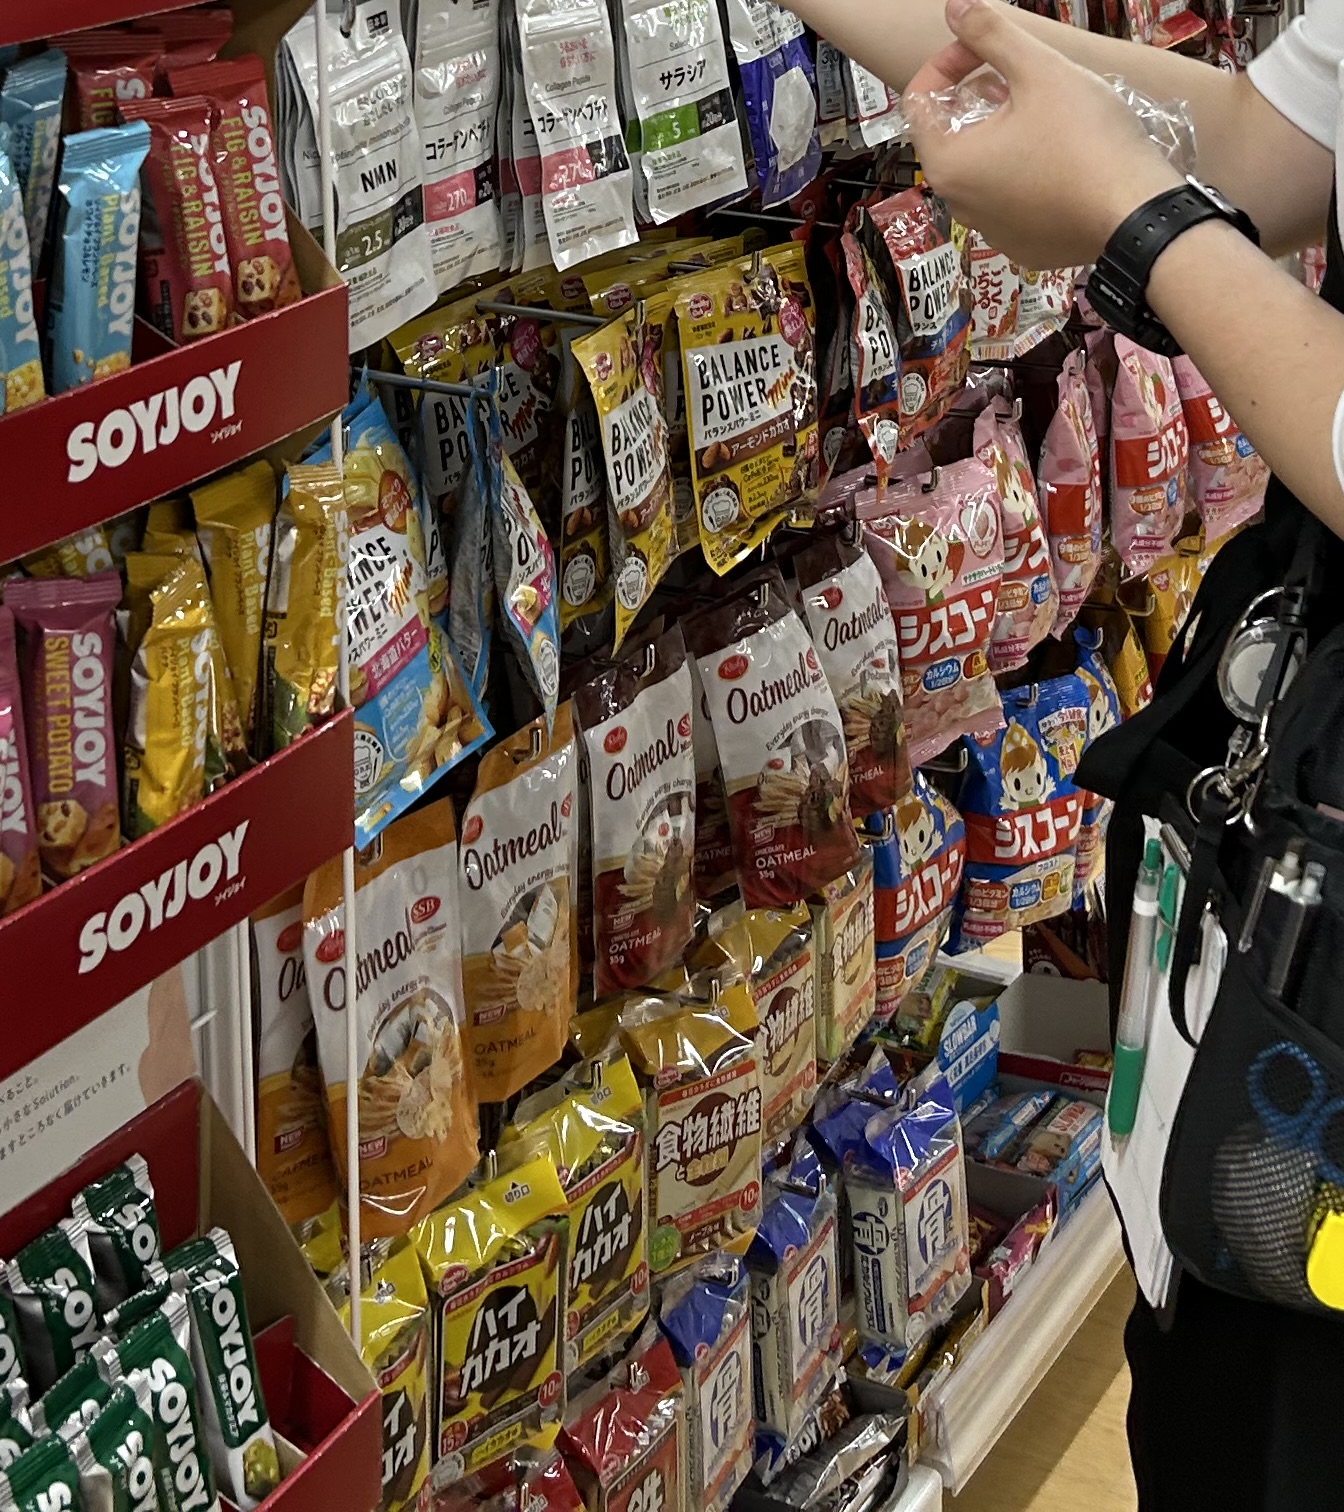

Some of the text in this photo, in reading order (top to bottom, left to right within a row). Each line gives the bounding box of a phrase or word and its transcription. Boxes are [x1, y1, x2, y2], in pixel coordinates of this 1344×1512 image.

[659, 58, 707, 90] サラシア
[181, 184, 198, 198] &
[220, 115, 266, 248] FIG & RAISIN
[241, 105, 290, 244] SOYJOY
[360, 158, 398, 193] NMN
[190, 134, 232, 277] SOYJOY
[110, 189, 141, 336] SOYJOY
[182, 201, 217, 279] RAISIN
[361, 229, 383, 257] 2.5
[908, 249, 956, 293] BALANCE
[698, 343, 781, 390] BALANCE
[66, 359, 244, 484] SOYJOY
[701, 376, 767, 426] POWER
[210, 419, 244, 445] ソイジョイ
[731, 417, 790, 457] アーモンドカカオ
[824, 587, 884, 651] Oatmeal
[727, 652, 811, 724] Oatmeal
[925, 662, 959, 681] カルシウム
[42, 635, 74, 793] SWEET POTATO
[71, 631, 107, 788] SOYJOY
[606, 719, 679, 801] Oatmeal
[463, 801, 564, 892] Oatmeal
[756, 844, 817, 870] OATMEAL
[995, 799, 1083, 859] シスコーン
[78, 820, 251, 976] SOYJOY
[213, 875, 247, 907] ソイジョイ
[526, 866, 556, 888] energy
[895, 849, 964, 934] シスコーン
[413, 899, 439, 920] SSB
[613, 913, 634, 928] NEW
[609, 926, 662, 954] OATMEAL
[474, 1027, 537, 1056] OATMEAL
[478, 1006, 504, 1023] NEW
[360, 1138, 386, 1157] NEW
[656, 1088, 760, 1172] 食物繊維
[505, 1186, 531, 1204] 切り口
[581, 1180, 622, 1244] ハイ
[572, 1212, 632, 1290] カカオ
[193, 1268, 259, 1426] SOYJOY
[470, 1285, 528, 1351] ハイ
[459, 1321, 541, 1399] カカオ
